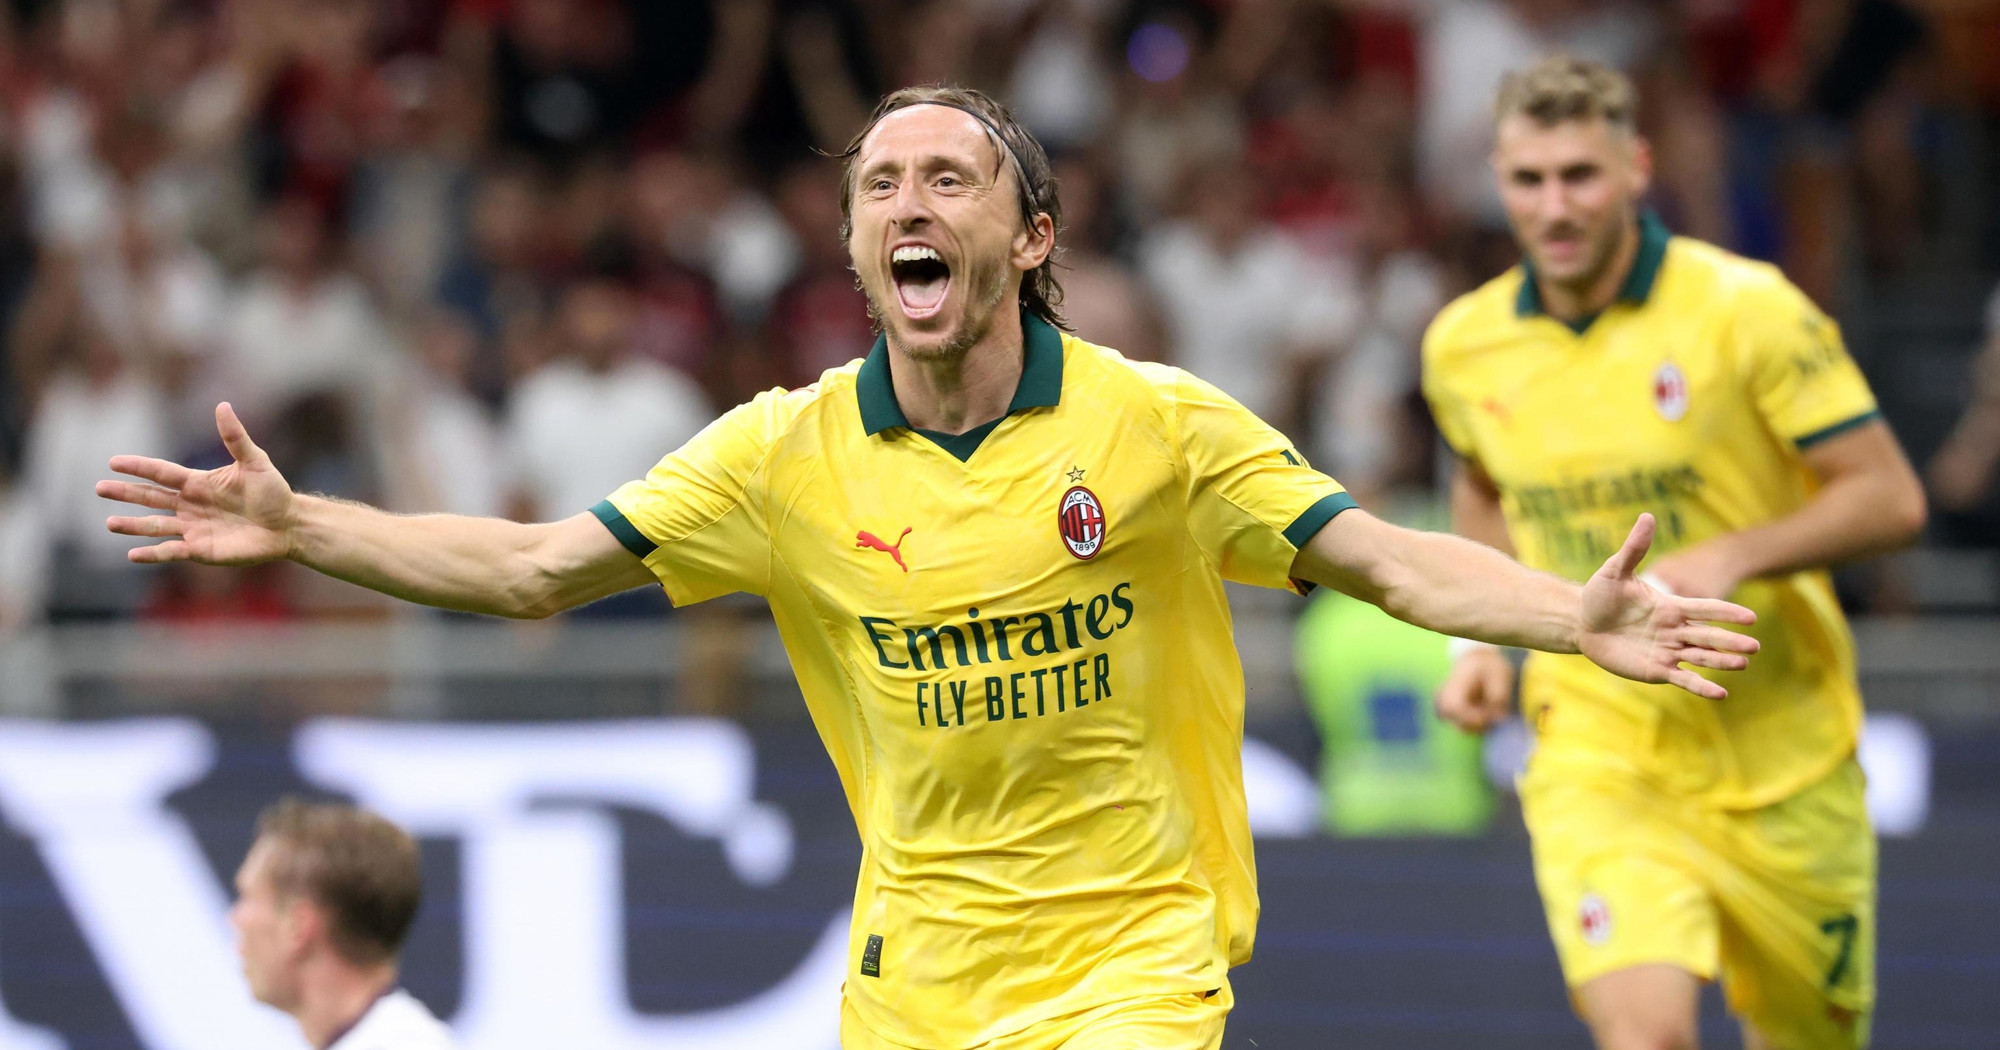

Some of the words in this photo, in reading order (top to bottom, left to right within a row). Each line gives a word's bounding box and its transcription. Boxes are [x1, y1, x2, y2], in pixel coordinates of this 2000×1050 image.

[1067, 492, 1092, 506] ACM
[1074, 541, 1096, 551] 1899
[858, 582, 1134, 671] Emirates
[916, 680, 967, 727] FLY
[985, 652, 1112, 722] BETTER
[1821, 912, 1858, 988] 7
